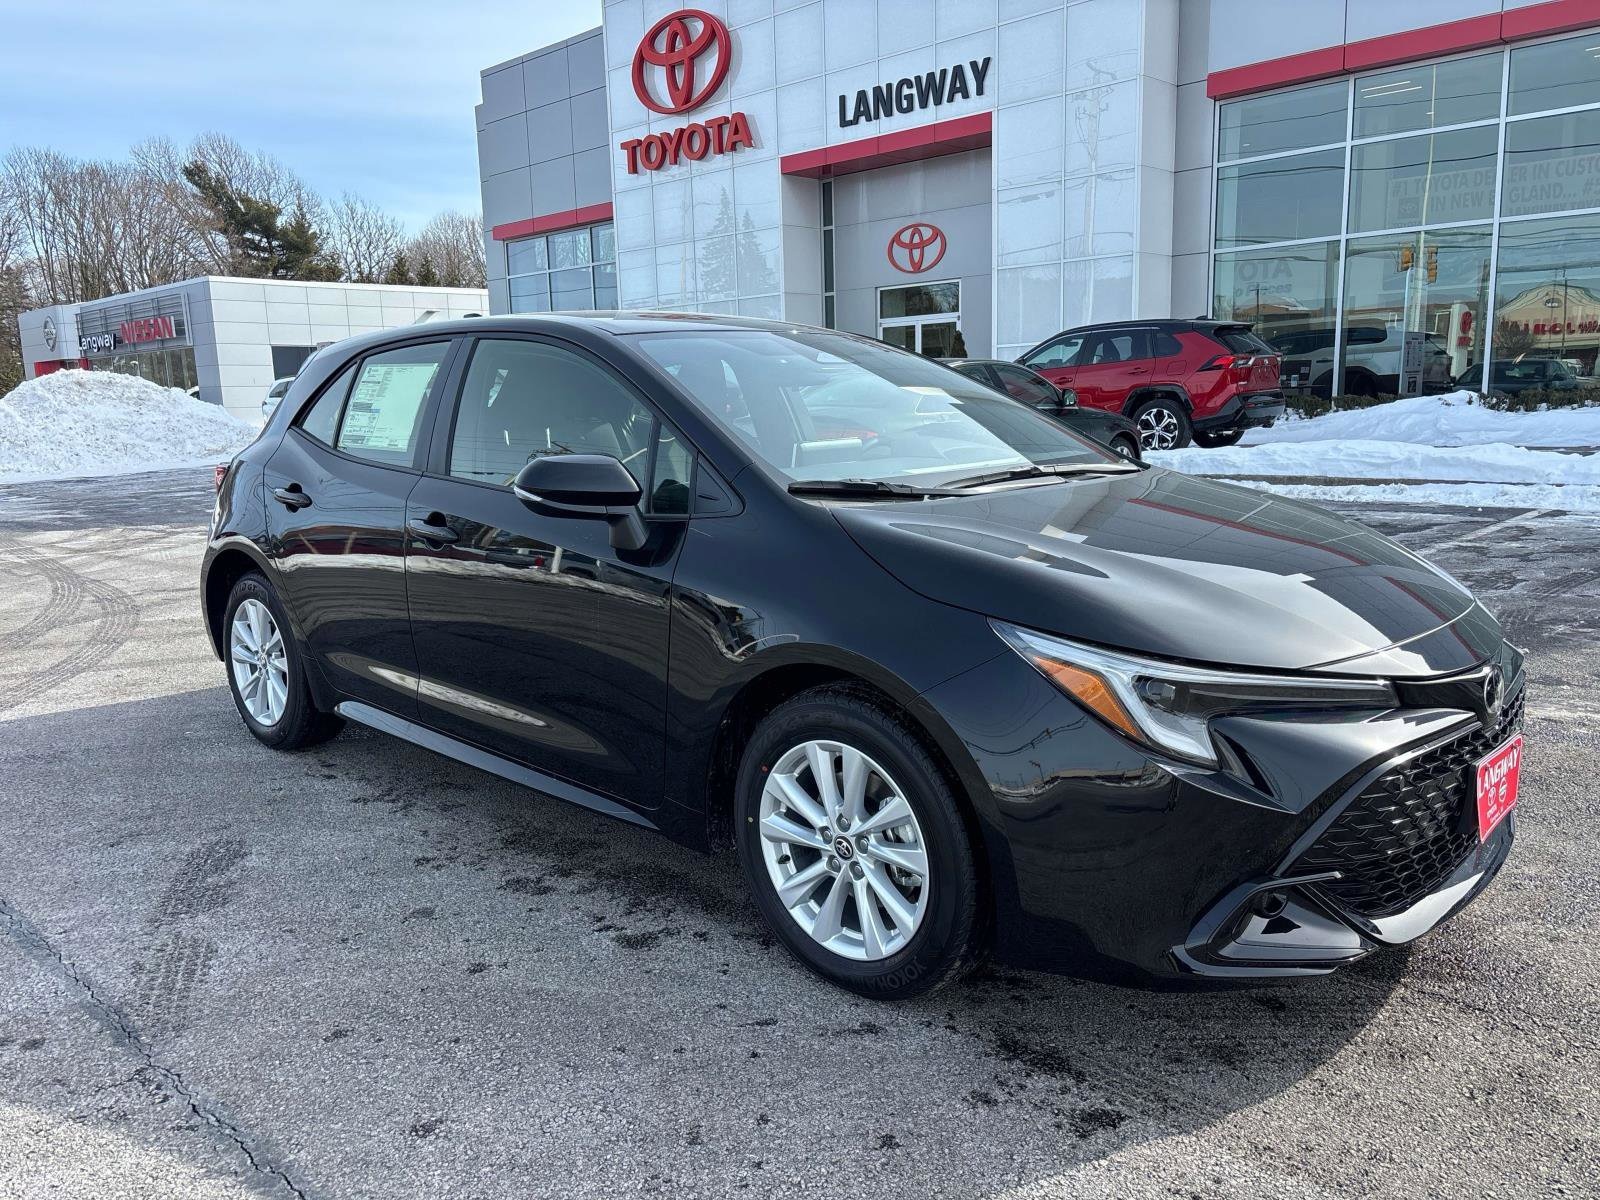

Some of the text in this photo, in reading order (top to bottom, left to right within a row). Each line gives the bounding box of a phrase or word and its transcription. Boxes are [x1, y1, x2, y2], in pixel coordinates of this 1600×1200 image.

[838, 56, 992, 128] LANGWAY
[620, 112, 754, 175] TOYOTA
[1414, 172, 1468, 195] TOYOTA
[1531, 161, 1551, 181] IN
[1430, 195, 1446, 212] IN
[1450, 190, 1484, 211] NEW
[78, 315, 176, 352] Langway NISSAN
[1477, 749, 1519, 799] LANGWAY
